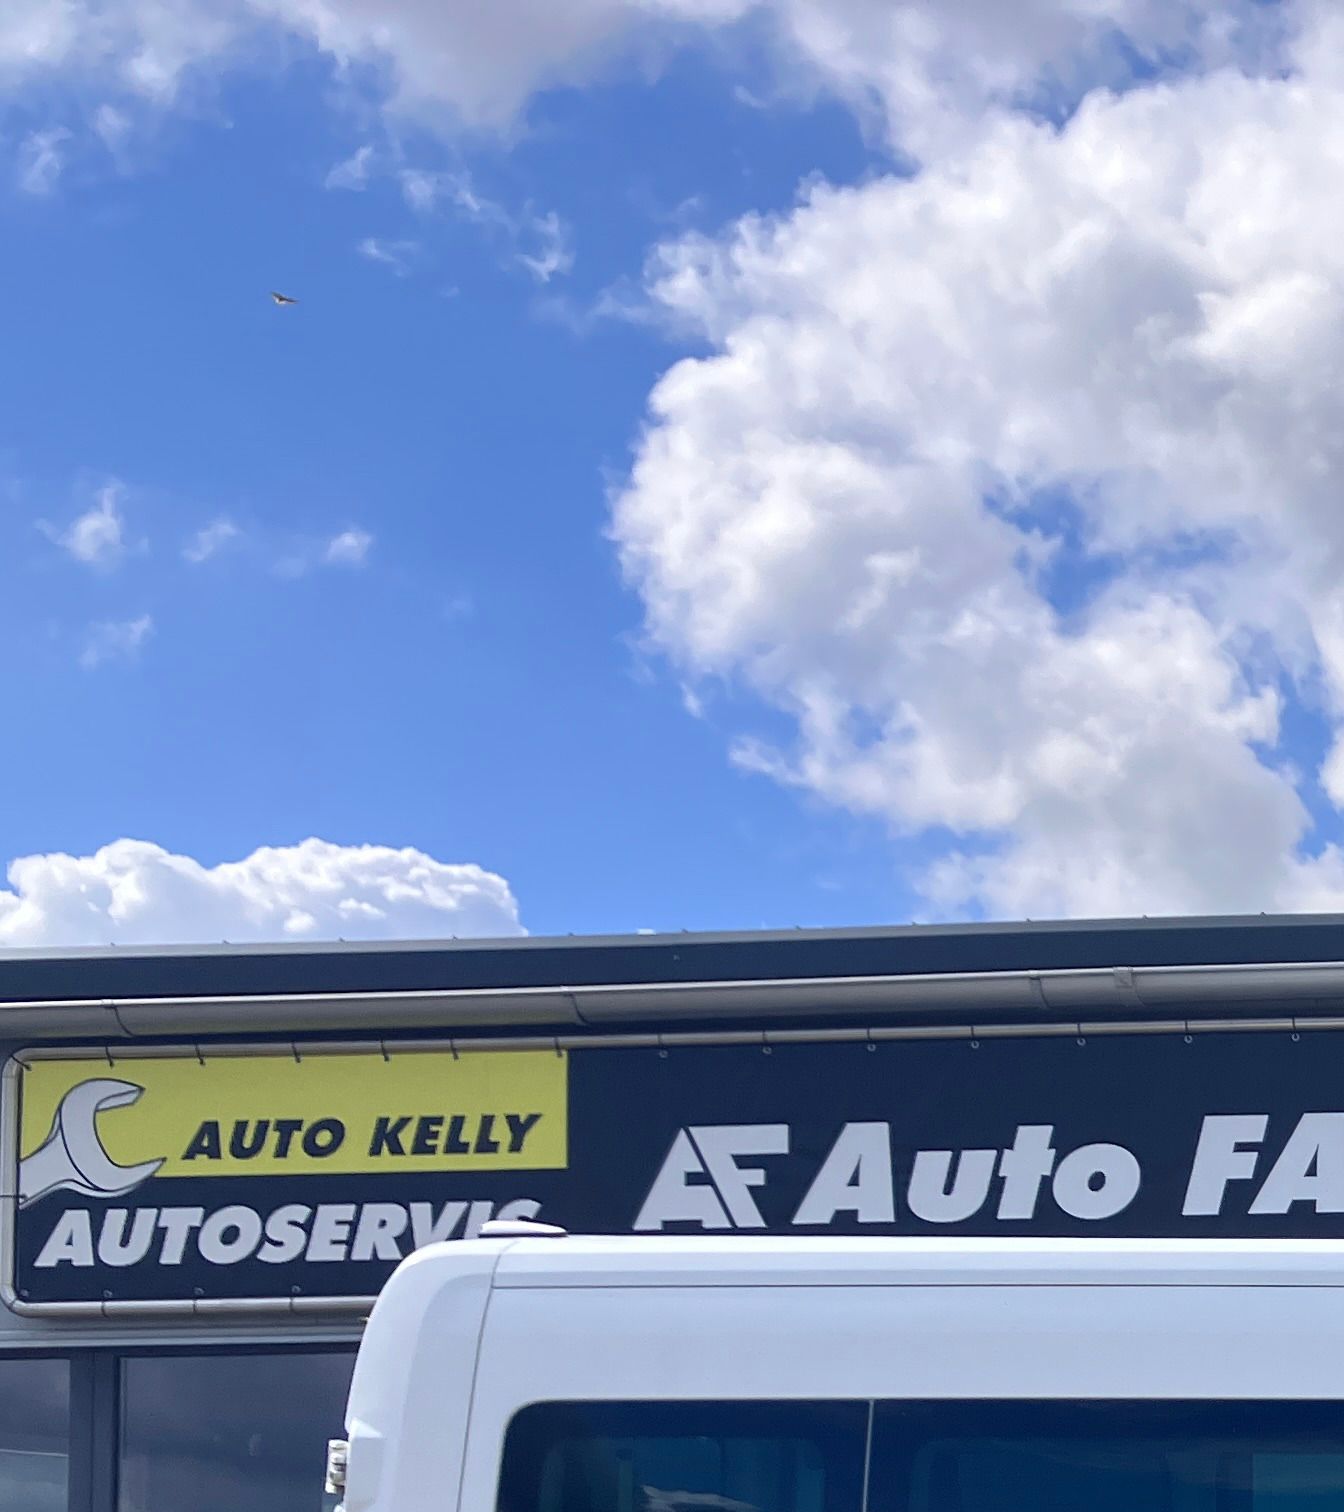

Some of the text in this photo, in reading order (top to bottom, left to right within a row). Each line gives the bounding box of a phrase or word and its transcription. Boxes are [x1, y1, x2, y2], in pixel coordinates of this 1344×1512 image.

[183, 1112, 545, 1161] AUTO KELLY
[791, 1121, 1142, 1224] Auto
